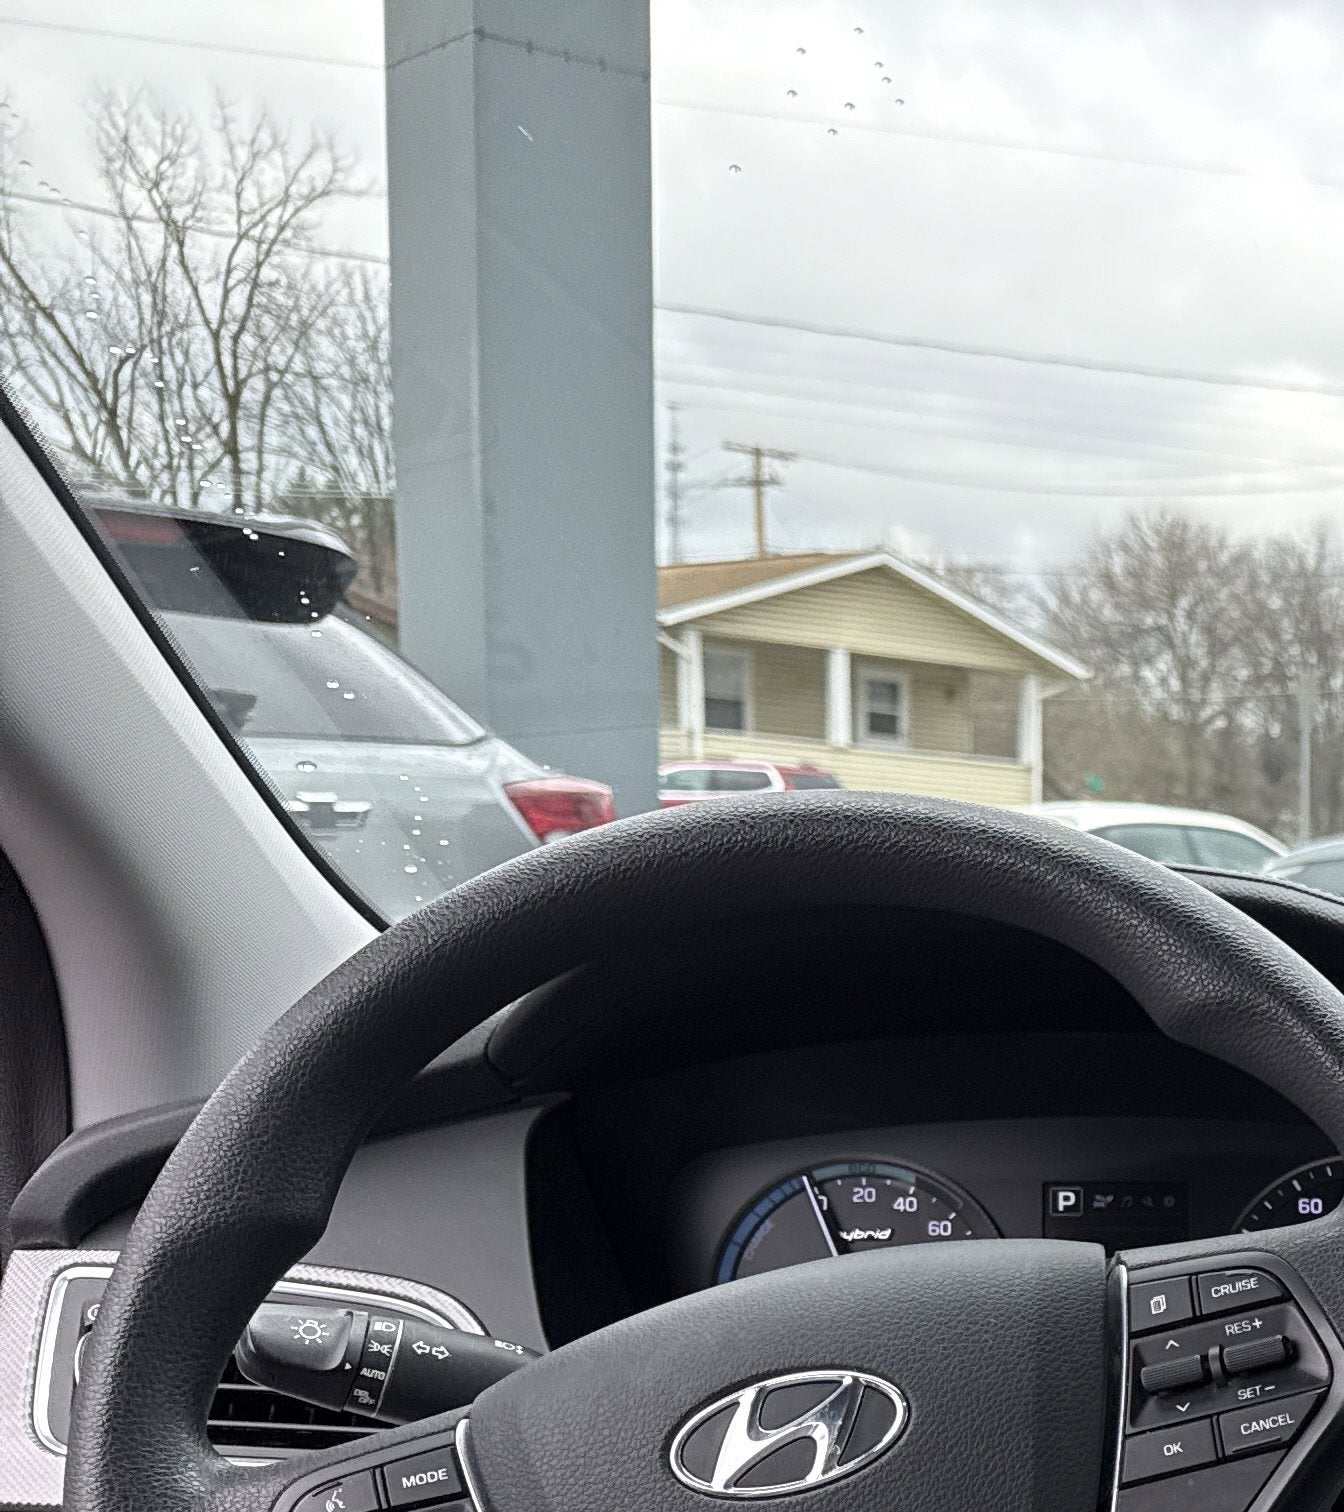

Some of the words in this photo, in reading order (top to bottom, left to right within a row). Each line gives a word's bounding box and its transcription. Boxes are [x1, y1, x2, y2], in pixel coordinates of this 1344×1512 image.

[852, 1188, 876, 1202] 20
[1057, 1191, 1076, 1212] P
[893, 1196, 917, 1212] 40
[1298, 1198, 1323, 1214] 60
[840, 1228, 892, 1241] ybrid
[927, 1220, 952, 1236] 60
[1211, 1277, 1260, 1298] CRUISE
[360, 1367, 386, 1380] AUTO
[1241, 1413, 1295, 1435] CANCEL
[1163, 1442, 1183, 1456] OK
[402, 1468, 449, 1488] MODE
